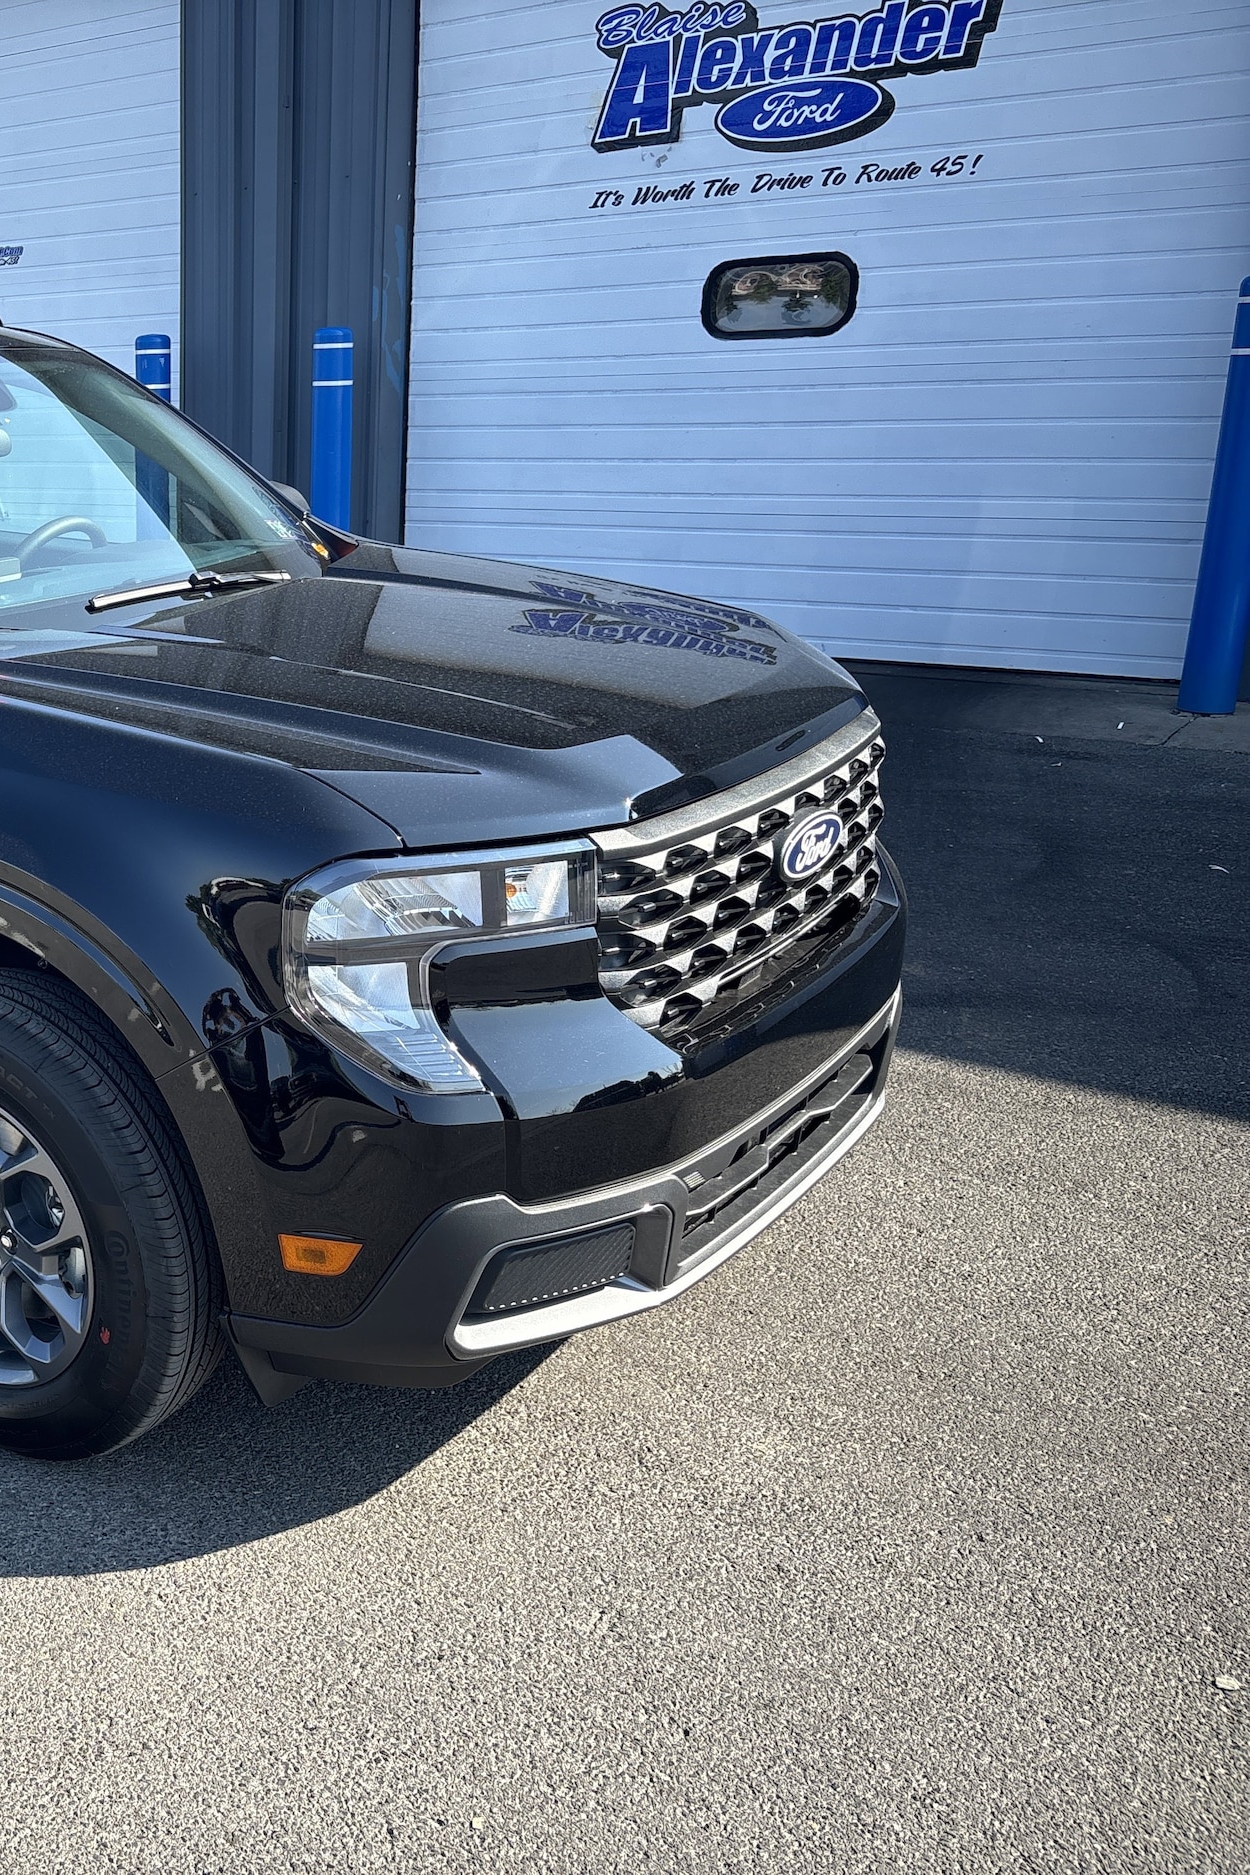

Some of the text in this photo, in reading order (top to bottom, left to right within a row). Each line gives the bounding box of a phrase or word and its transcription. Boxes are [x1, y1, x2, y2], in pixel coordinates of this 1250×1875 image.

[599, 2, 747, 48] Blaise
[595, 0, 986, 143] Alexander
[753, 88, 844, 131] Ford
[588, 190, 625, 209] It's
[631, 180, 696, 206] Worth
[703, 177, 740, 199] The
[750, 173, 813, 194] Drive
[821, 166, 847, 187] To
[854, 161, 922, 185] Route
[795, 823, 835, 872] Ford
